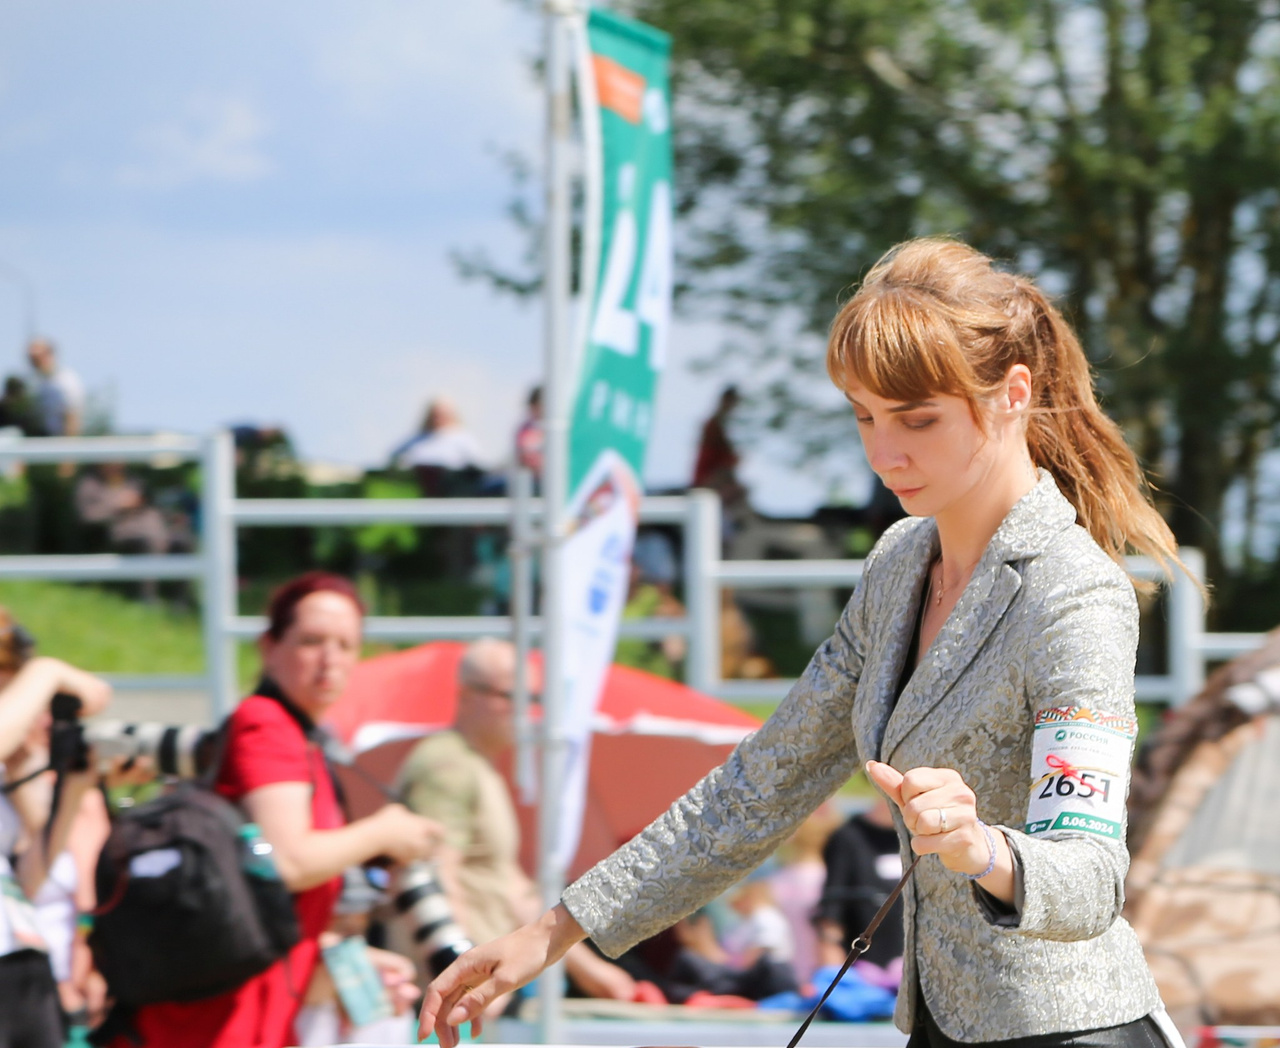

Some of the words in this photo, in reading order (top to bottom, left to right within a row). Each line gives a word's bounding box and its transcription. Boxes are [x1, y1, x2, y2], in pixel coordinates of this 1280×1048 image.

[1069, 731, 1109, 745] РОССИЯ
[1038, 772, 1112, 803] 2651
[1061, 815, 1114, 835] 8.06.2024
